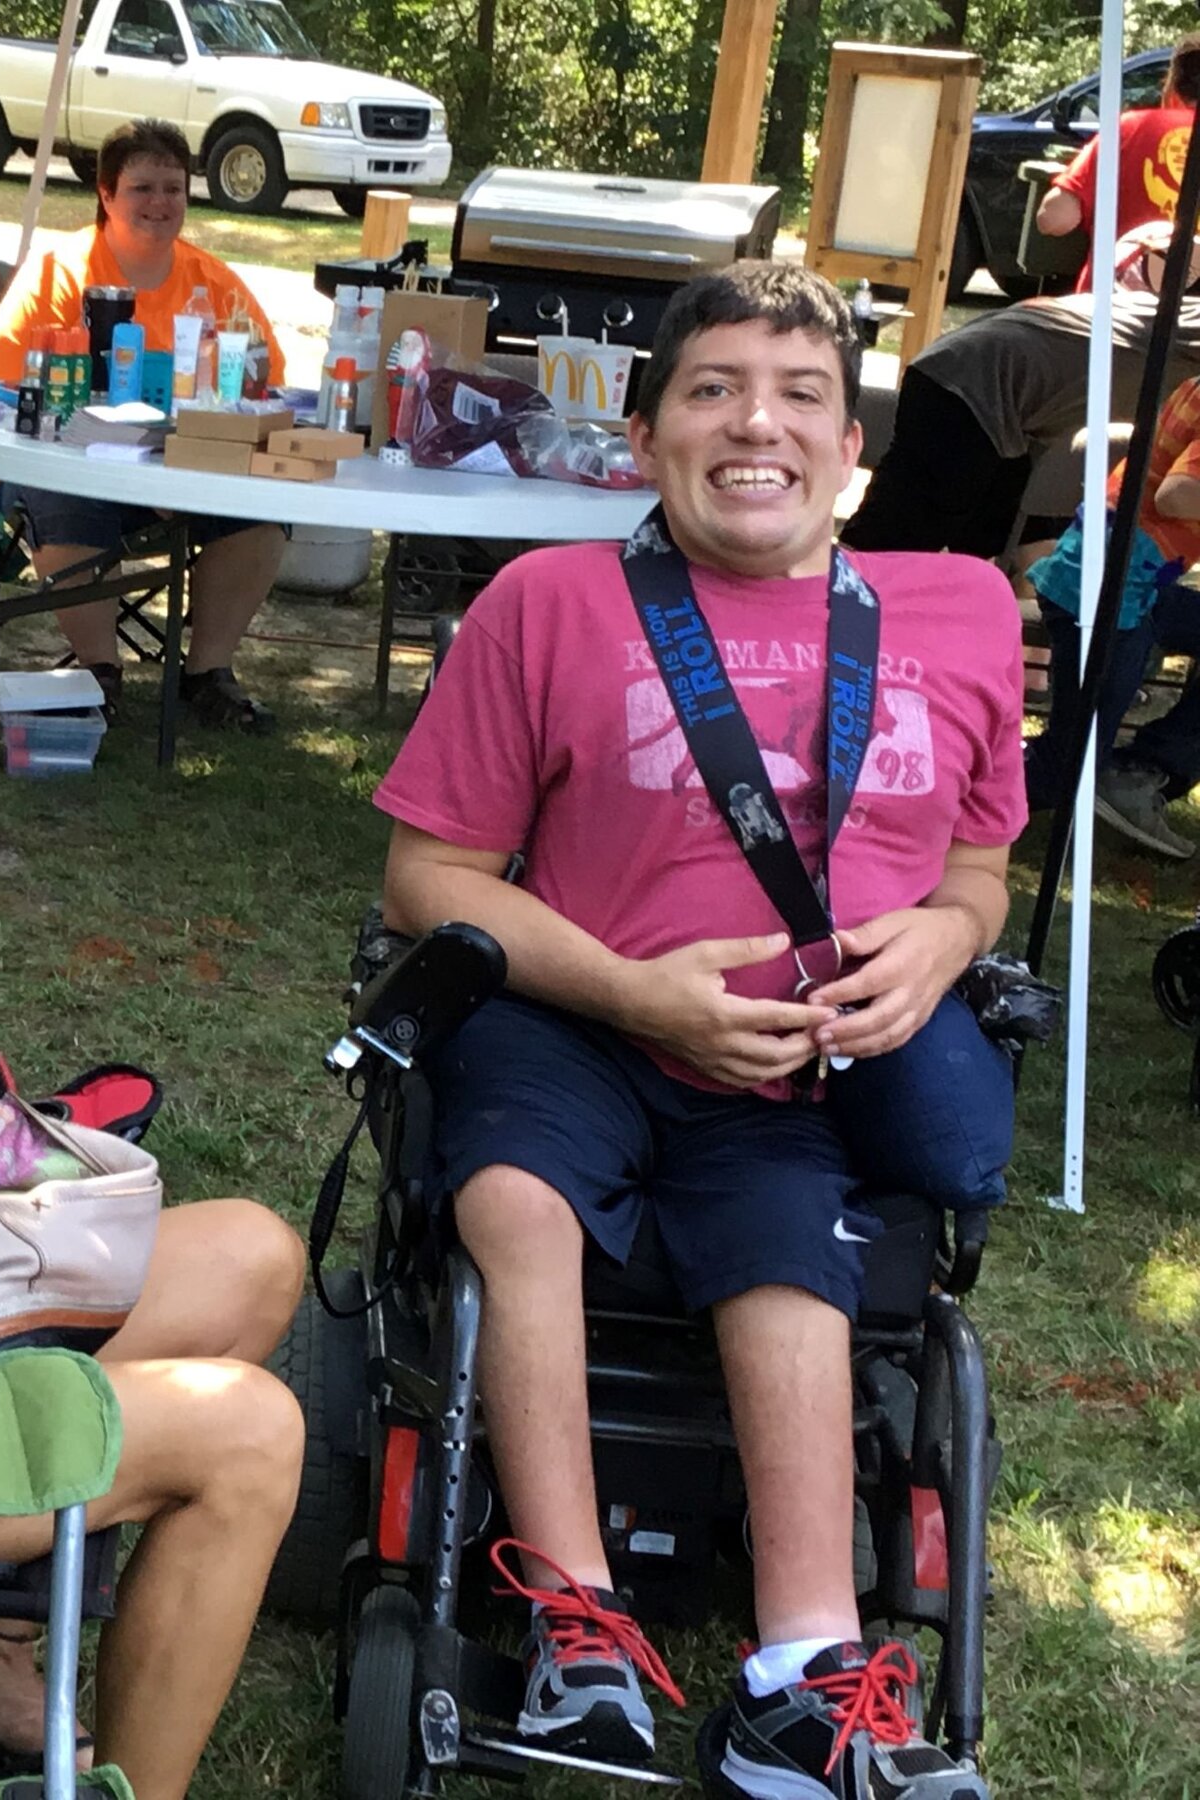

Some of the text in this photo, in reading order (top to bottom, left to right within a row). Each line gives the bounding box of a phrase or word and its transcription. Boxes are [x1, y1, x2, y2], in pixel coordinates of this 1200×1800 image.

[643, 604, 702, 727] THIS IS HOW
[664, 596, 737, 721] I ROLL
[855, 665, 873, 713] THIS
[831, 652, 859, 780] I ROLL
[854, 715, 868, 739] IS
[876, 748, 926, 791] 98
